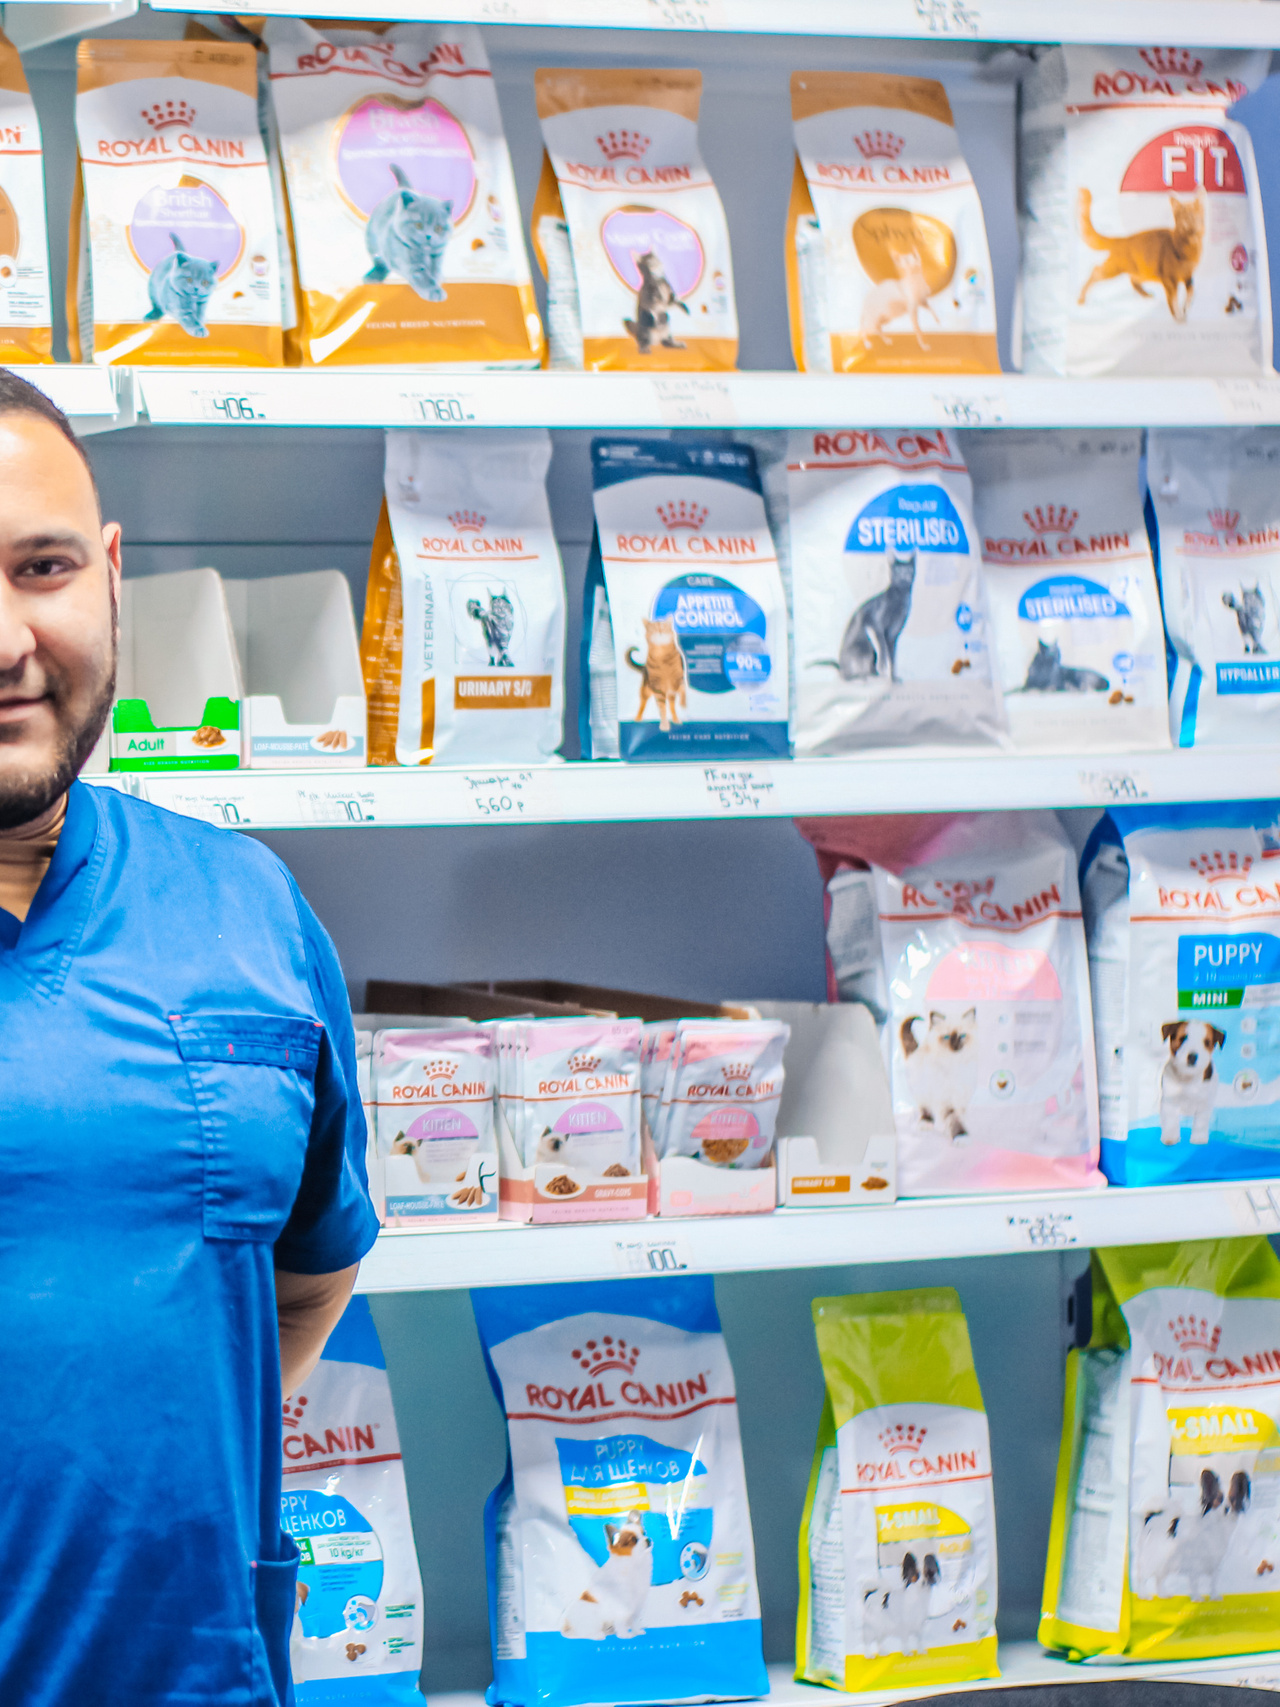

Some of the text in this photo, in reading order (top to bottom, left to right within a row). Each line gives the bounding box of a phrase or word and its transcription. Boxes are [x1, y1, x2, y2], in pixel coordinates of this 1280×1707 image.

[1093, 70, 1182, 97] ROYAL
[98, 133, 245, 158] ROYAL CANIN
[567, 162, 692, 185] ROYAL CANIN
[817, 161, 951, 185] ROYAL CANIN
[1161, 146, 1228, 187] FIT
[433, 319, 485, 328] NUTRITION
[858, 515, 960, 547] STERILISED
[422, 536, 524, 554] ROYAL CANIN
[617, 535, 756, 555] ROYAL CANIN
[984, 532, 1130, 557] ROYAL CANIN
[685, 576, 715, 586] CARE
[677, 594, 735, 610] APPETITE
[424, 572, 434, 673] VETERINARY
[674, 610, 744, 628] CONTROL
[458, 679, 511, 697] URINARY
[127, 738, 165, 752] Adult
[475, 795, 513, 815] 560
[1159, 886, 1231, 912] ROYAL
[1194, 943, 1263, 966] PUPPY
[1193, 991, 1228, 1006] MINI
[393, 1081, 486, 1099] ROYAL CANIN
[538, 1073, 630, 1095] ROYAL CANIN
[687, 1080, 774, 1097] ROYAL CANIN
[422, 1117, 461, 1131] KITTEN
[569, 1111, 607, 1127] KITTEN
[526, 1373, 708, 1411] ROYAL CANIN
[283, 1423, 376, 1460] CANIN
[595, 1439, 645, 1461] PUPPY
[571, 1459, 680, 1482] ДЛЯ ЩЕНКОВ
[856, 1450, 977, 1482] ROYAL CANIN
[879, 1508, 940, 1531] X-SMALL
[329, 1547, 340, 1558] 10
